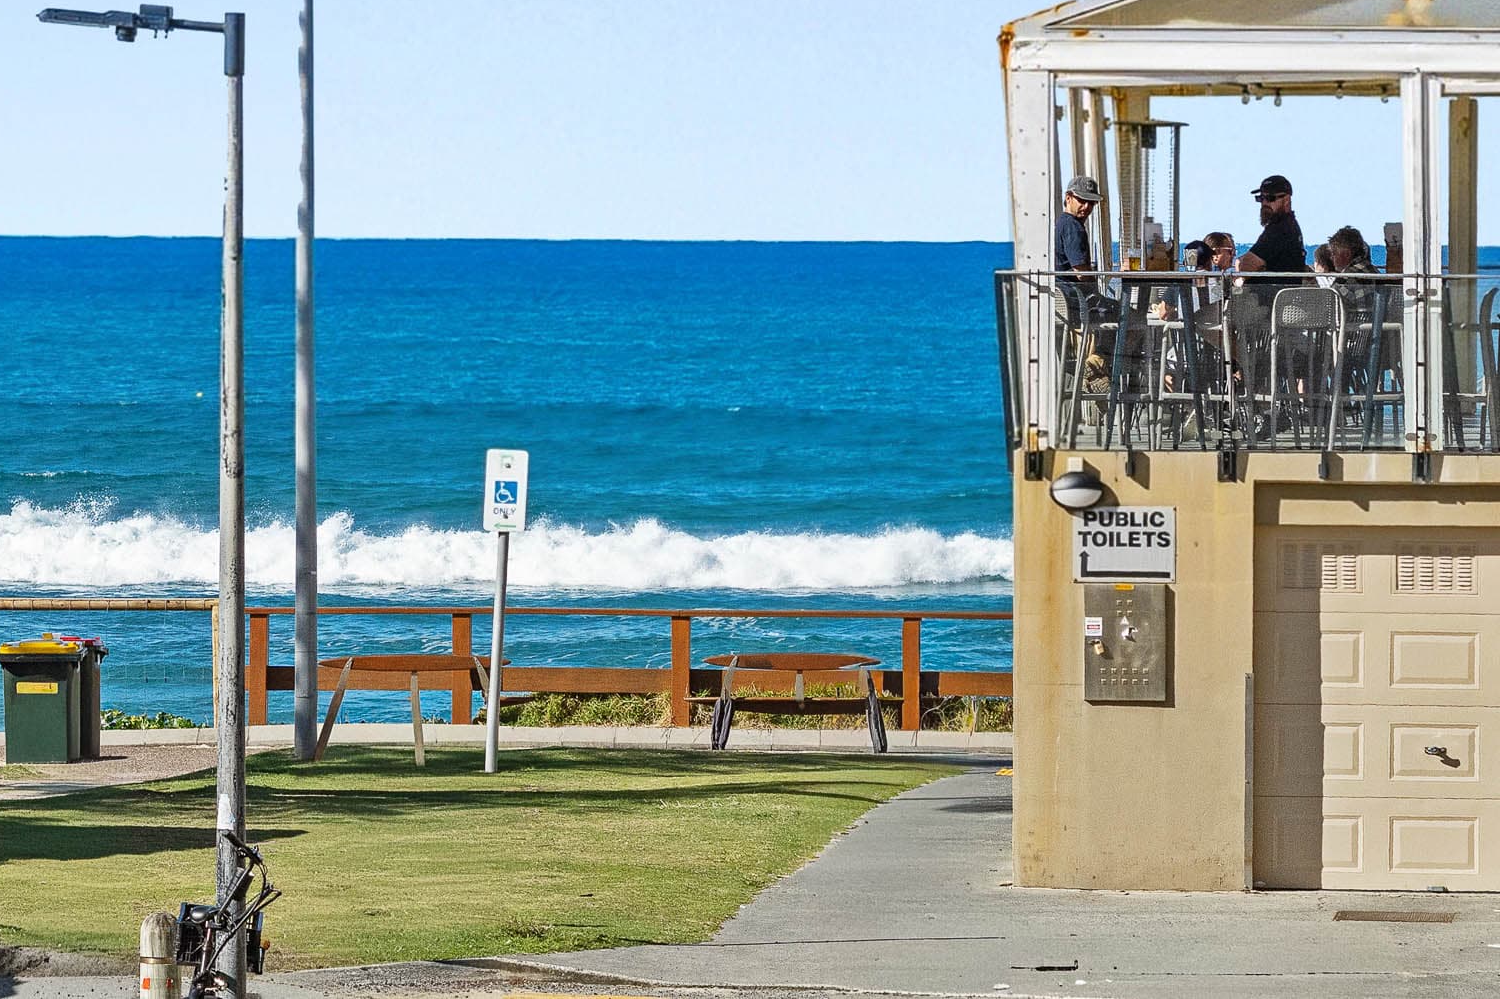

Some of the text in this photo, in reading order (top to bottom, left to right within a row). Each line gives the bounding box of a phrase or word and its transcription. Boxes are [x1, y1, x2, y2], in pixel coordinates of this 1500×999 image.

[493, 507, 516, 516] ONLY
[1083, 511, 1165, 528] PUBLIC
[1078, 531, 1171, 548] TOILETS
